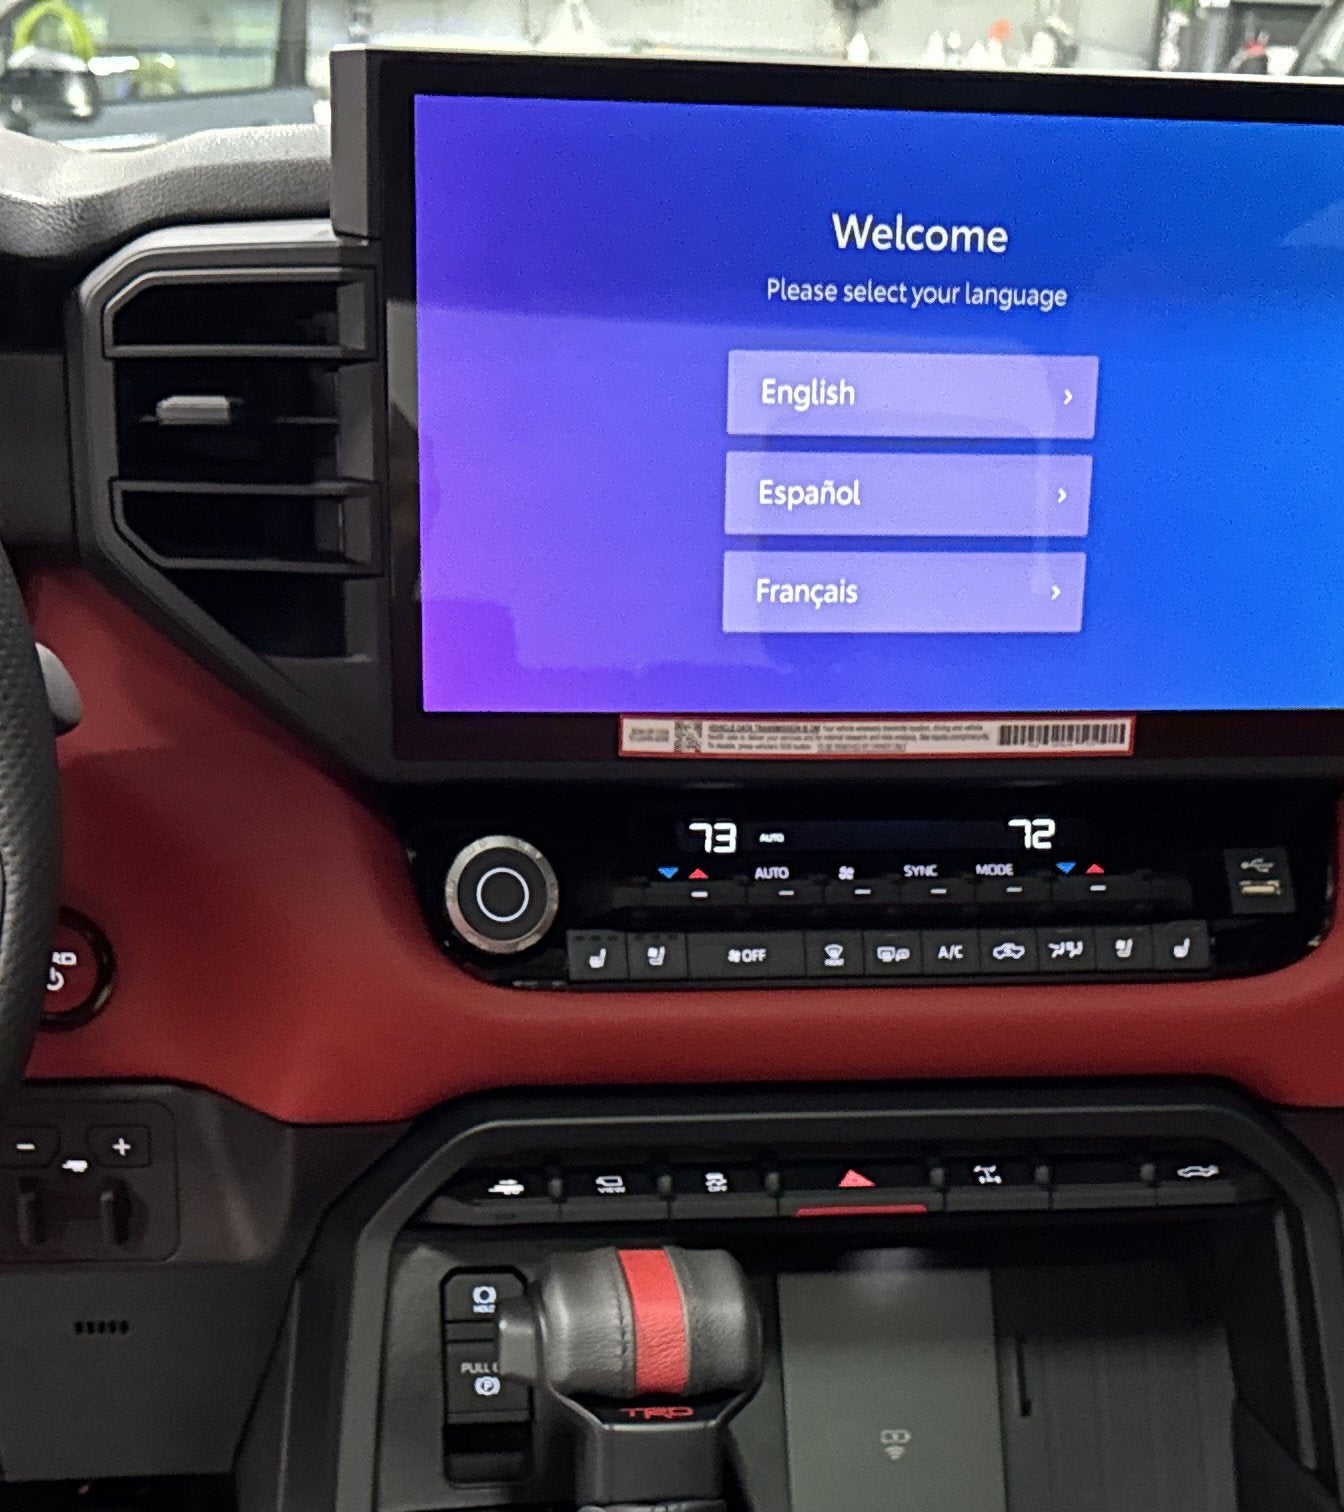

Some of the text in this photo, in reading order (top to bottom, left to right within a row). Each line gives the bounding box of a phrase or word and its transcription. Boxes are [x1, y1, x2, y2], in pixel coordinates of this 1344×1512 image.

[832, 212, 1009, 254] Welcome
[767, 277, 1068, 312] Please select your language
[761, 378, 855, 411] English
[758, 479, 861, 511] Español
[756, 577, 858, 610] Français
[689, 822, 785, 853] 73 AUTO
[1008, 818, 1056, 849] 72
[754, 866, 790, 880] AUTO
[904, 864, 938, 878] SYNC
[975, 863, 1014, 877] MODE
[742, 949, 766, 963] OFF
[938, 945, 964, 960] A/C
[460, 1362, 490, 1374] PULL
[619, 1406, 694, 1420] TRD
